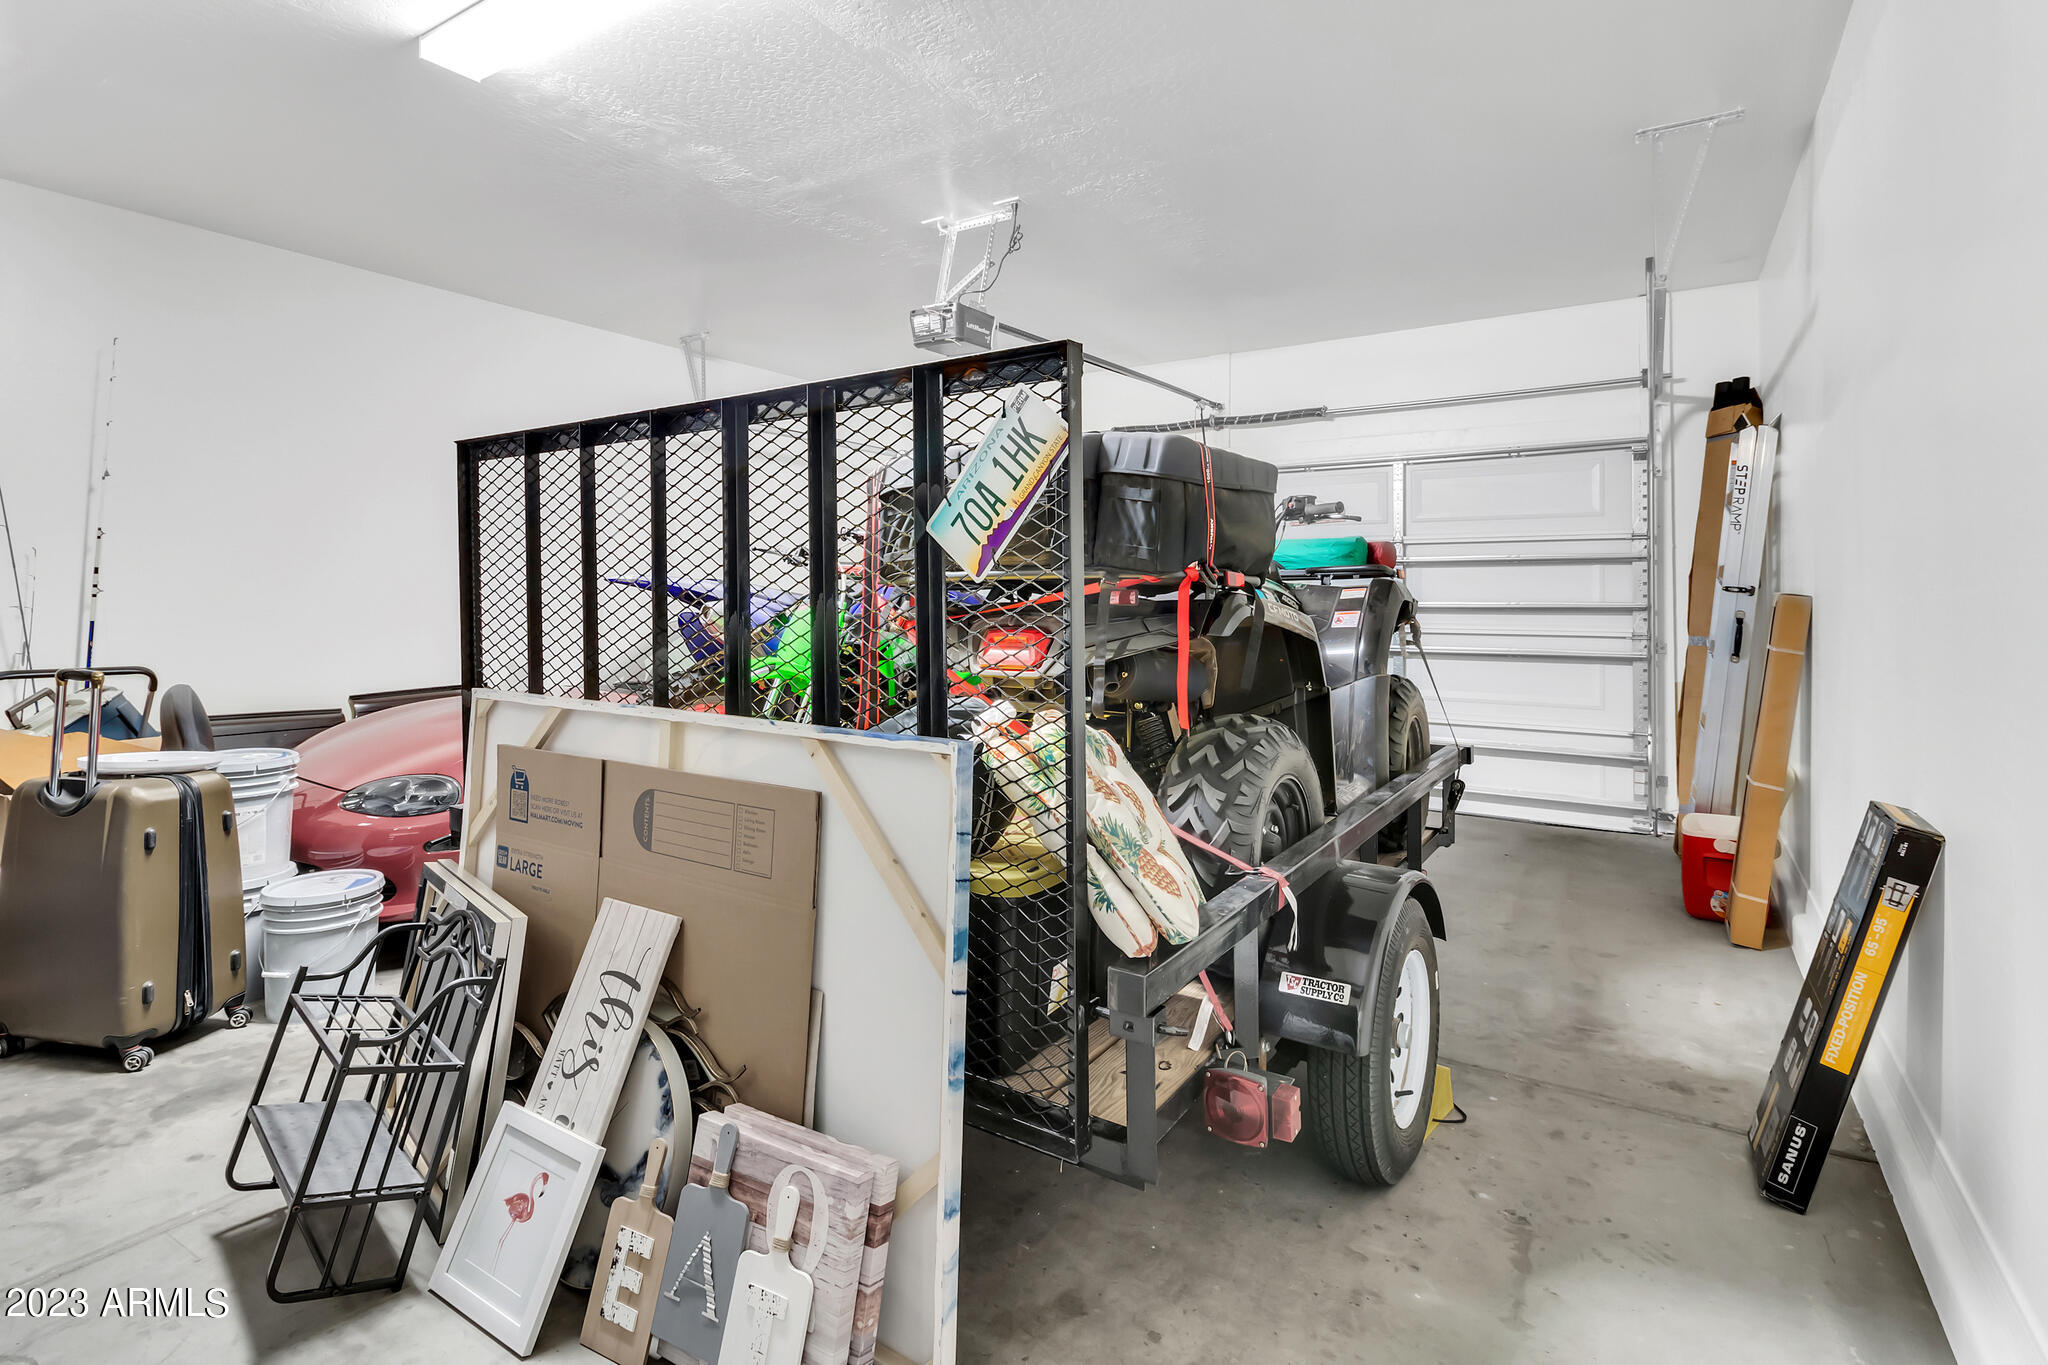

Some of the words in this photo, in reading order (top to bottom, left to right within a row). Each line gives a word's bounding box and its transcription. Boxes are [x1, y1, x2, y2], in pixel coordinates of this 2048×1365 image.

[955, 426, 1004, 500] ARIZONA
[992, 416, 1048, 492] 1HK
[1019, 477, 1035, 499] GRAND
[1033, 452, 1052, 480] CANYON
[1049, 434, 1063, 454] STATE
[510, 856, 543, 879] LARGE
[1300, 986, 1334, 1000] SUPPLY
[1302, 977, 1345, 993] TRACTOR
[1825, 971, 1868, 1065] FIXED-POSITION
[551, 1049, 566, 1079] MATT
[1777, 1125, 1807, 1185] SANUS
